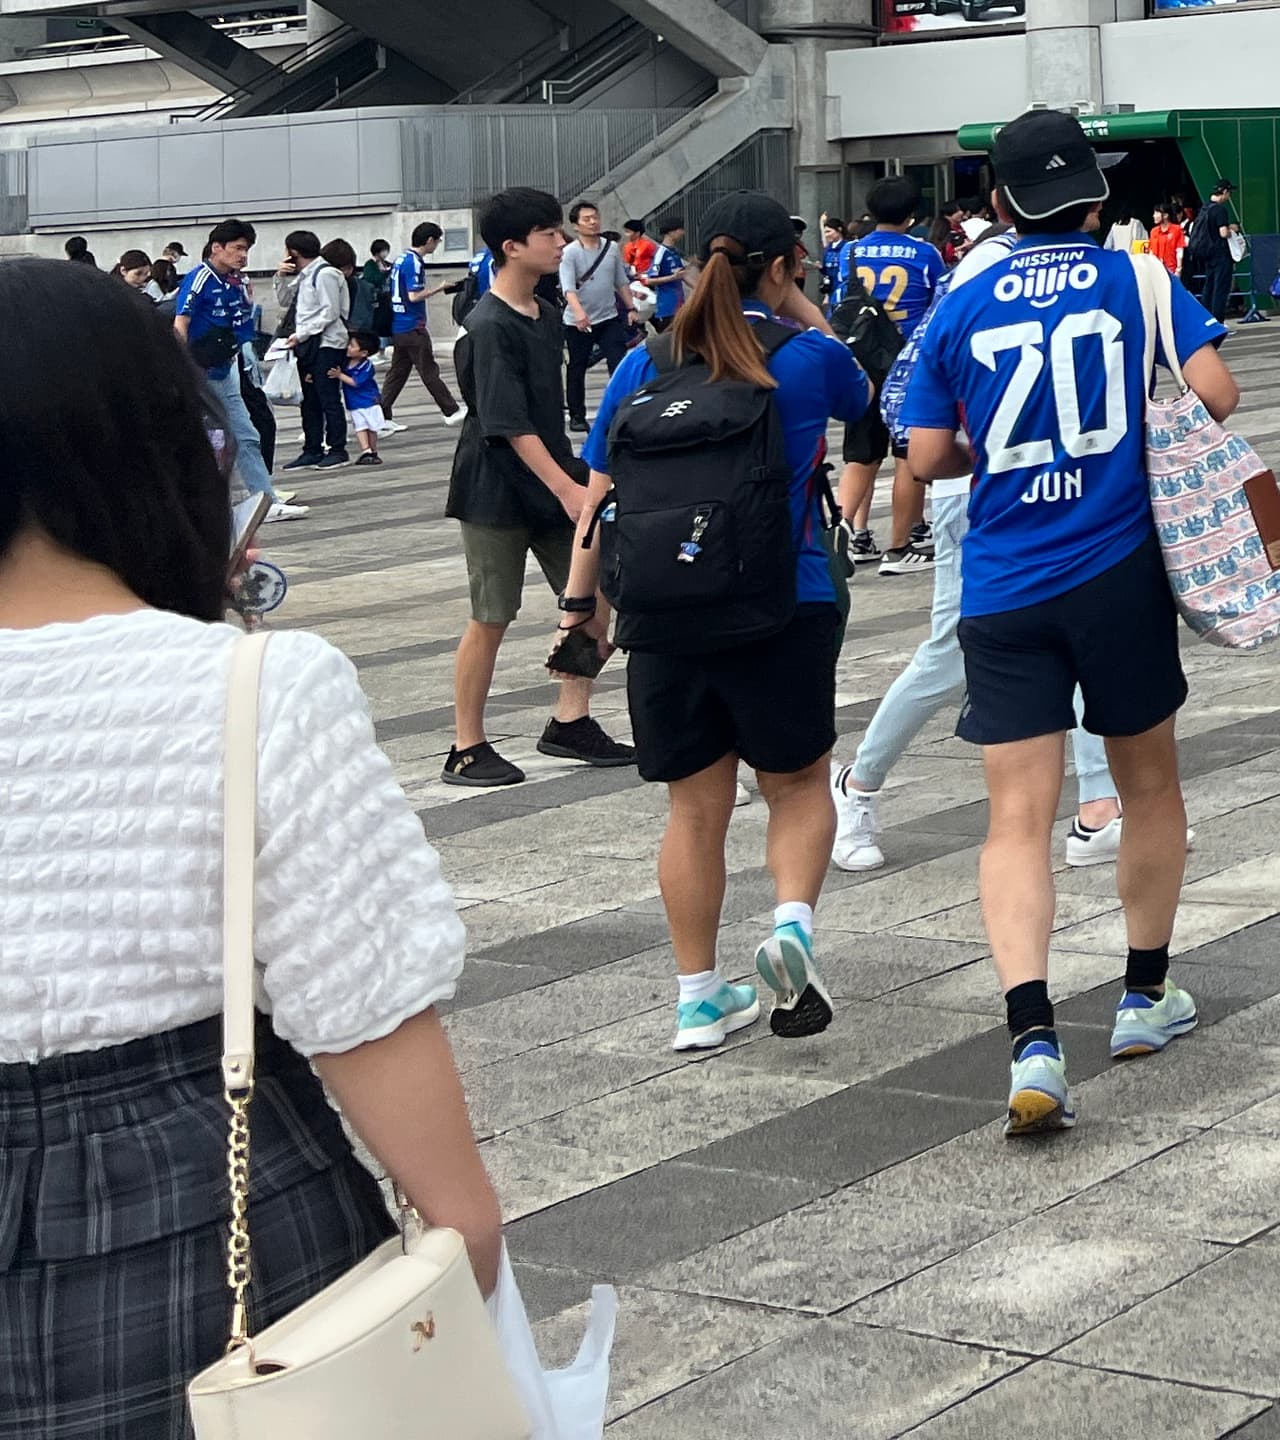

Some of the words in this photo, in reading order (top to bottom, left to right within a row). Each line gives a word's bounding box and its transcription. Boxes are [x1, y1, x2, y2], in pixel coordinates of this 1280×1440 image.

[1010, 250, 1084, 270] NISSHIN
[970, 309, 1128, 474] 20
[1020, 468, 1083, 504] JUN
